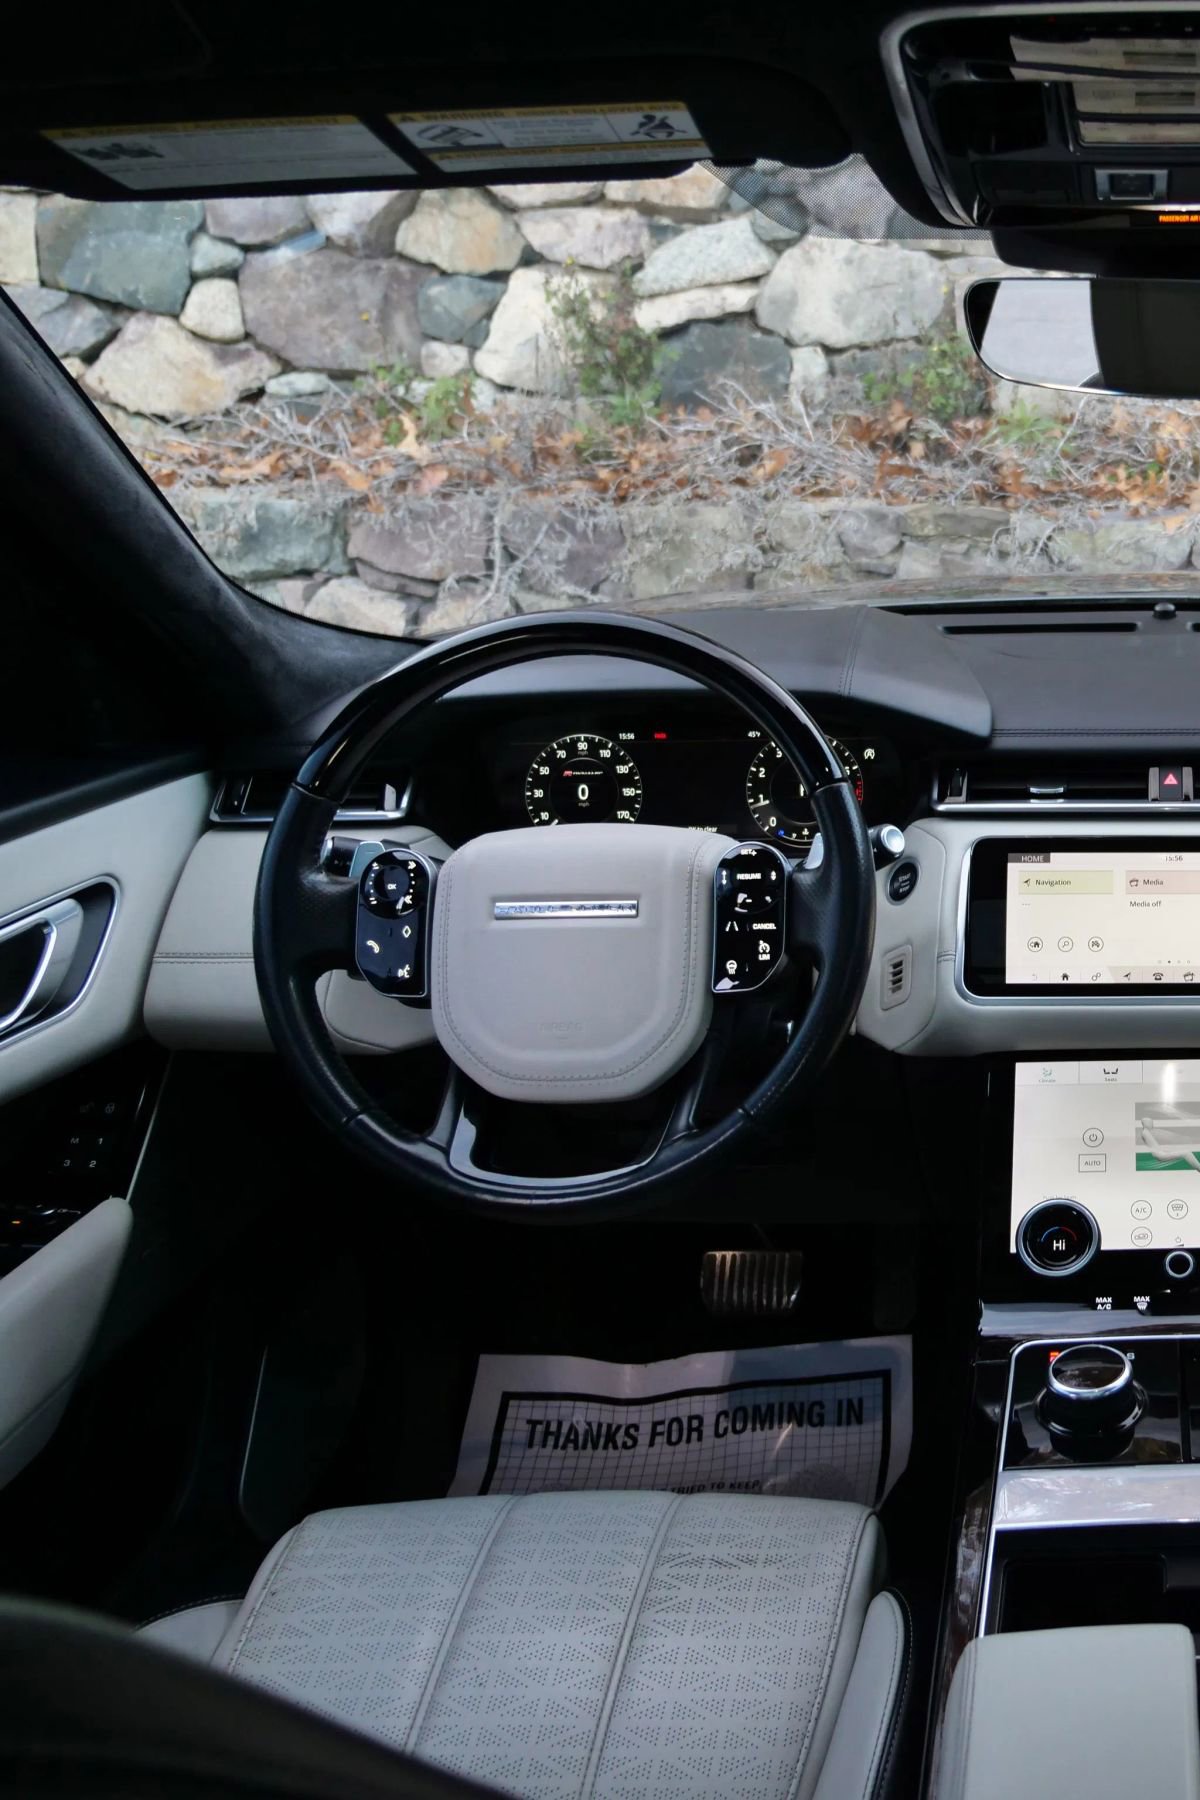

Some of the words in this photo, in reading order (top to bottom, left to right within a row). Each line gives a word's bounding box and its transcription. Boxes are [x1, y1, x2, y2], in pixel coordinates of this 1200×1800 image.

[556, 750, 566, 758] 70
[600, 750, 611, 758] 110
[540, 767, 549, 775] 50
[616, 765, 629, 773] 130
[759, 768, 765, 778] 2
[533, 789, 543, 798] 30
[578, 784, 589, 800] 0
[622, 788, 635, 796] 150
[540, 812, 549, 820] 10
[617, 811, 630, 819] 170
[770, 817, 776, 827] 0
[1035, 879, 1071, 887] Navigation
[1053, 1240, 1066, 1251] Hi
[526, 1418, 640, 1451] THANKS
[650, 1414, 704, 1448] FOR
[714, 1402, 825, 1438] COMING
[836, 1398, 864, 1427] IN
[710, 1482, 725, 1490] TO
